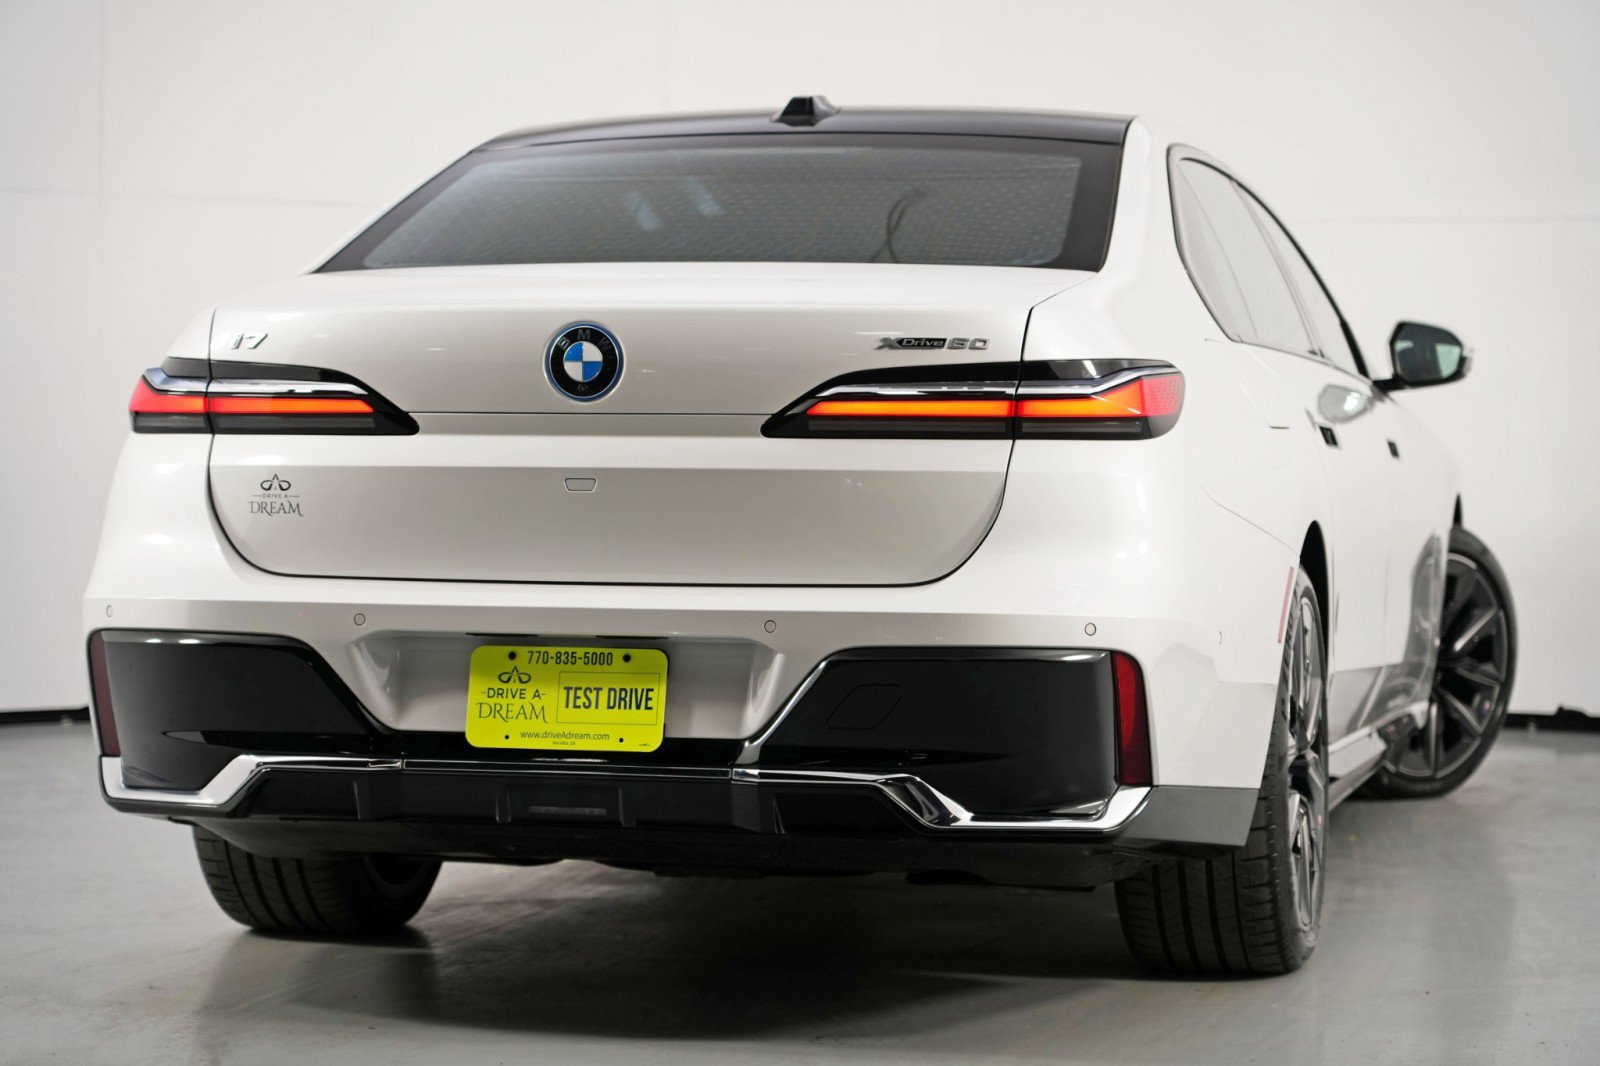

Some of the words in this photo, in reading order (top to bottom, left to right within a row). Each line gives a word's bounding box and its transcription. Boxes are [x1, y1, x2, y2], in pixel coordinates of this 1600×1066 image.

[557, 328, 612, 351] BMW
[248, 500, 304, 517] DREAM
[527, 650, 613, 666] 770-835-5000
[487, 687, 527, 700] DRIVE
[532, 689, 541, 700] A
[563, 686, 603, 710] TEST
[606, 687, 654, 711] DRIVE
[475, 702, 548, 724] DREAM
[520, 730, 610, 741] www.driveAdream.com
